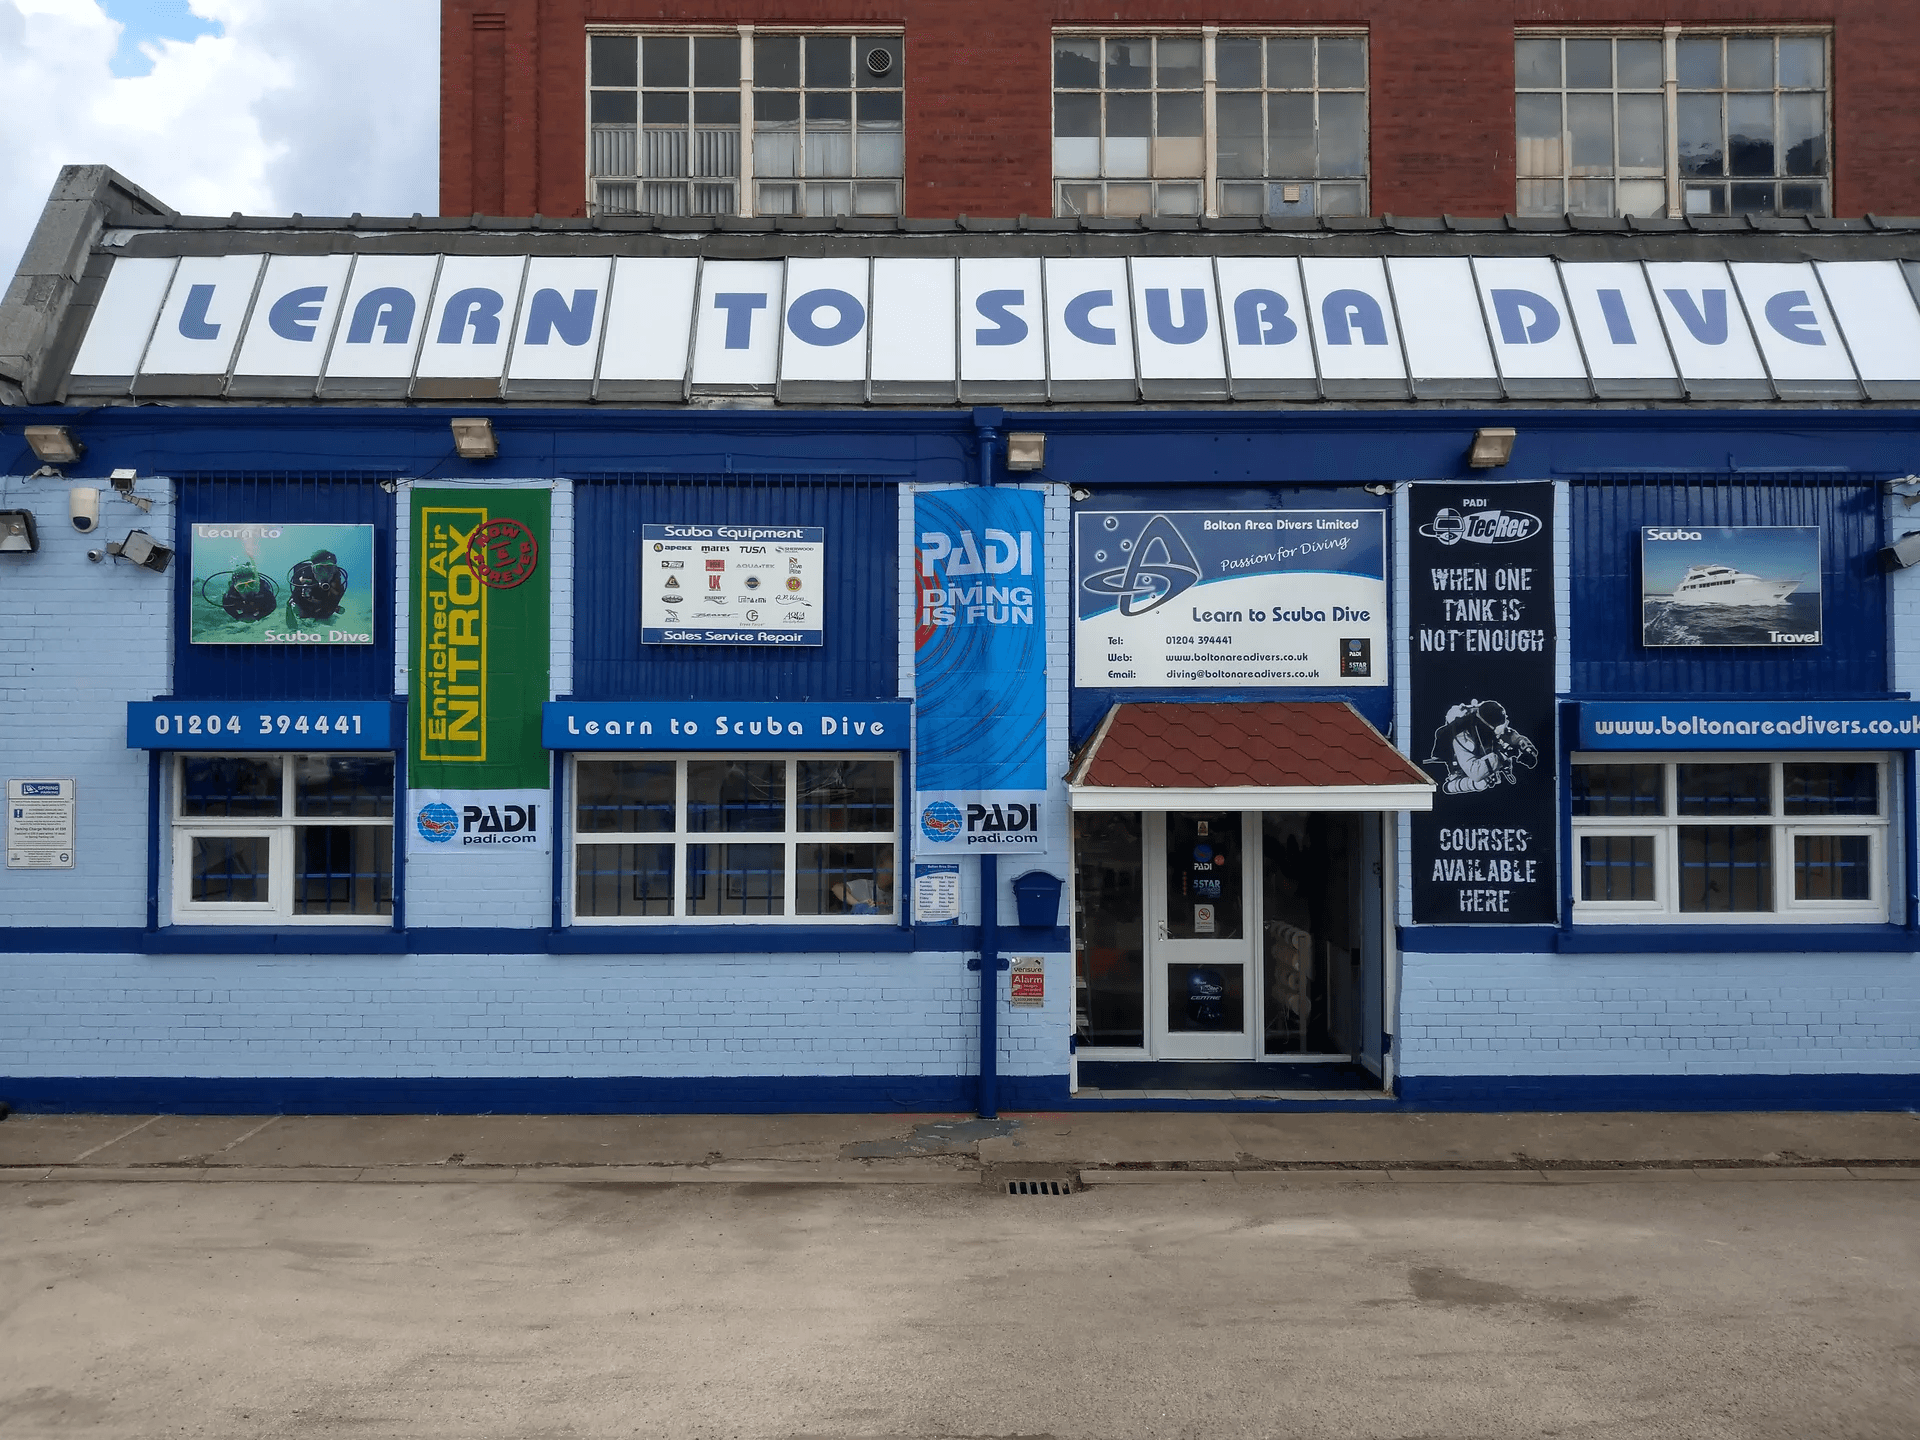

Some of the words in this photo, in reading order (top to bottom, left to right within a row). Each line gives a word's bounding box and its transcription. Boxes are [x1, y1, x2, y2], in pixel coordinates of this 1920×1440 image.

[178, 284, 598, 347] LEARN
[714, 288, 866, 349] TO
[975, 289, 1389, 346] SCUBA
[1490, 288, 1826, 345] DIVE
[1463, 499, 1487, 507] PADI
[198, 526, 252, 538] Learn
[260, 528, 281, 538] to
[664, 526, 712, 537] Scuba
[718, 528, 804, 540] Equipment
[1204, 520, 1241, 530] Bolton
[1245, 520, 1272, 530] Area
[1276, 520, 1312, 530] Divers
[1316, 519, 1358, 529] Limited
[1467, 515, 1530, 538] TecRec
[475, 525, 520, 548] NOW
[1647, 529, 1702, 541] Scuba
[429, 525, 447, 578] Air
[740, 546, 766, 554] TUSA
[921, 528, 1032, 577] PADI
[1220, 553, 1276, 571] Passion
[1276, 546, 1298, 561] for
[1300, 536, 1350, 554] Diving
[474, 542, 532, 583] FOREVER
[1431, 568, 1487, 591] WHEN
[1494, 568, 1532, 591] ONE
[923, 607, 956, 625] IS
[966, 605, 1033, 625] FUN
[1192, 607, 1242, 622] Learn
[1249, 608, 1266, 622] to
[1272, 607, 1326, 622] Scuba
[1332, 606, 1370, 622] Dive
[1443, 598, 1499, 621] TANK
[1502, 599, 1522, 621] IS
[264, 630, 321, 642] Scuba
[329, 630, 370, 642] Dive
[448, 524, 480, 741] NITROX
[664, 630, 702, 640] Sales
[705, 631, 754, 640] Service
[758, 632, 804, 643] Repair
[1108, 636, 1124, 646] Tel:
[1166, 636, 1195, 645] 01204
[1198, 636, 1232, 645] 394441
[1420, 629, 1457, 651] NOT
[1466, 629, 1544, 651] ENOUGH
[1768, 631, 1819, 643] Travel
[428, 591, 447, 740] Enriched
[1108, 653, 1132, 662] Web:
[1166, 652, 1308, 662] www.boltonareadivers.co.uk
[1108, 670, 1136, 679] Email:
[1166, 669, 1320, 680] diving@boltonareadivers.co.uk
[155, 715, 241, 734] 01204
[259, 715, 361, 734] 394441
[568, 716, 653, 735] Learn
[671, 718, 698, 735] to
[715, 716, 803, 735] Scuba
[821, 716, 885, 735] Dive
[1595, 715, 1920, 735] www.boltonareadivers.co.uk
[463, 805, 536, 832] PADI
[967, 804, 1037, 832] PADI
[463, 834, 537, 845] padi.com
[967, 833, 1038, 845] padi.com
[1440, 828, 1529, 851] COURSES
[1432, 859, 1537, 883] AVAILABLE
[1460, 889, 1510, 912] HERE
